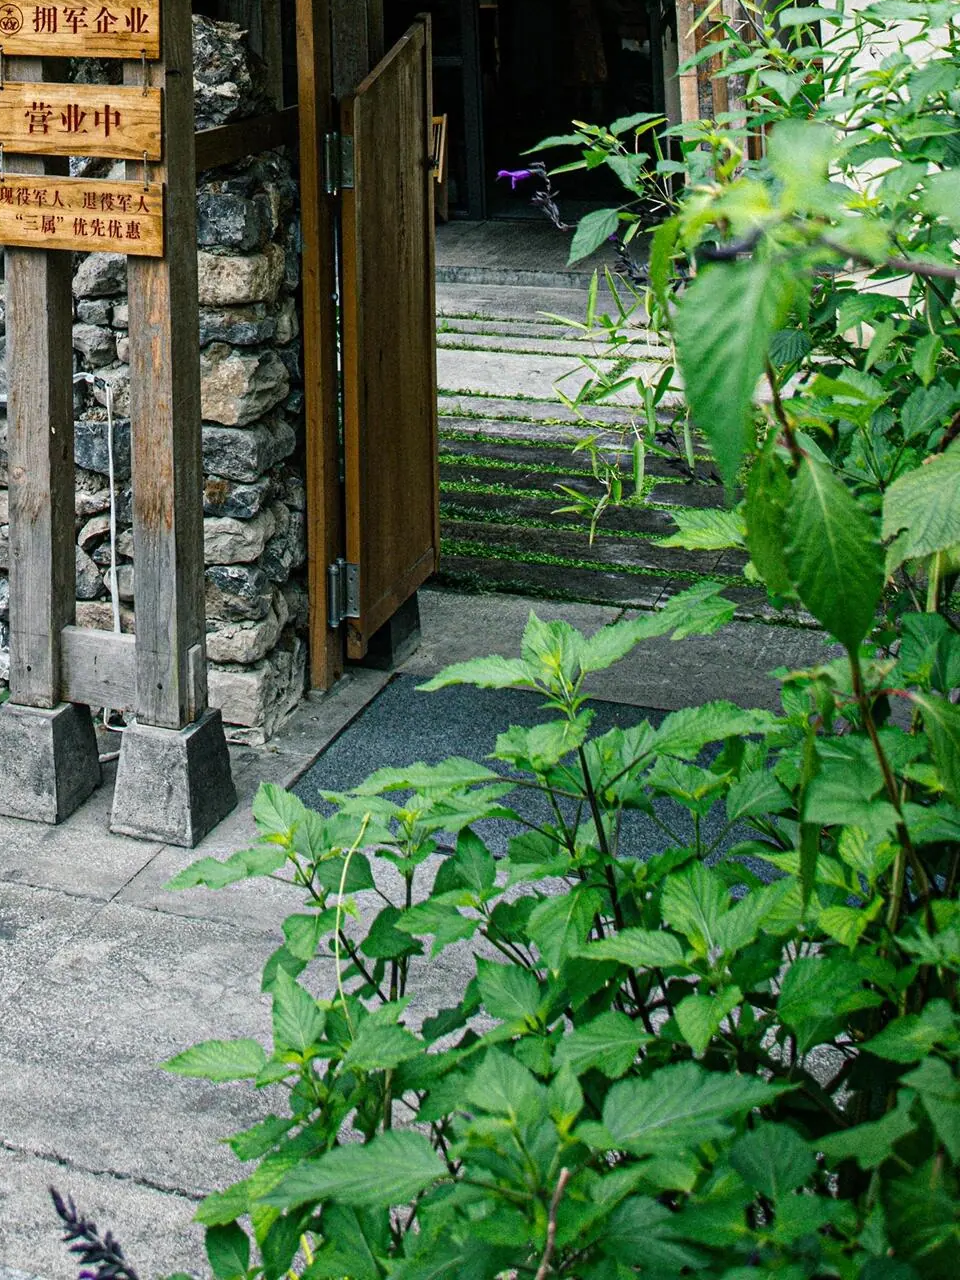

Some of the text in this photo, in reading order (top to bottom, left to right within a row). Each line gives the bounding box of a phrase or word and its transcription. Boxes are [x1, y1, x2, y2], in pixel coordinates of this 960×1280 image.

[31, 5, 150, 35] 拥军企业
[24, 101, 122, 137] 营业中
